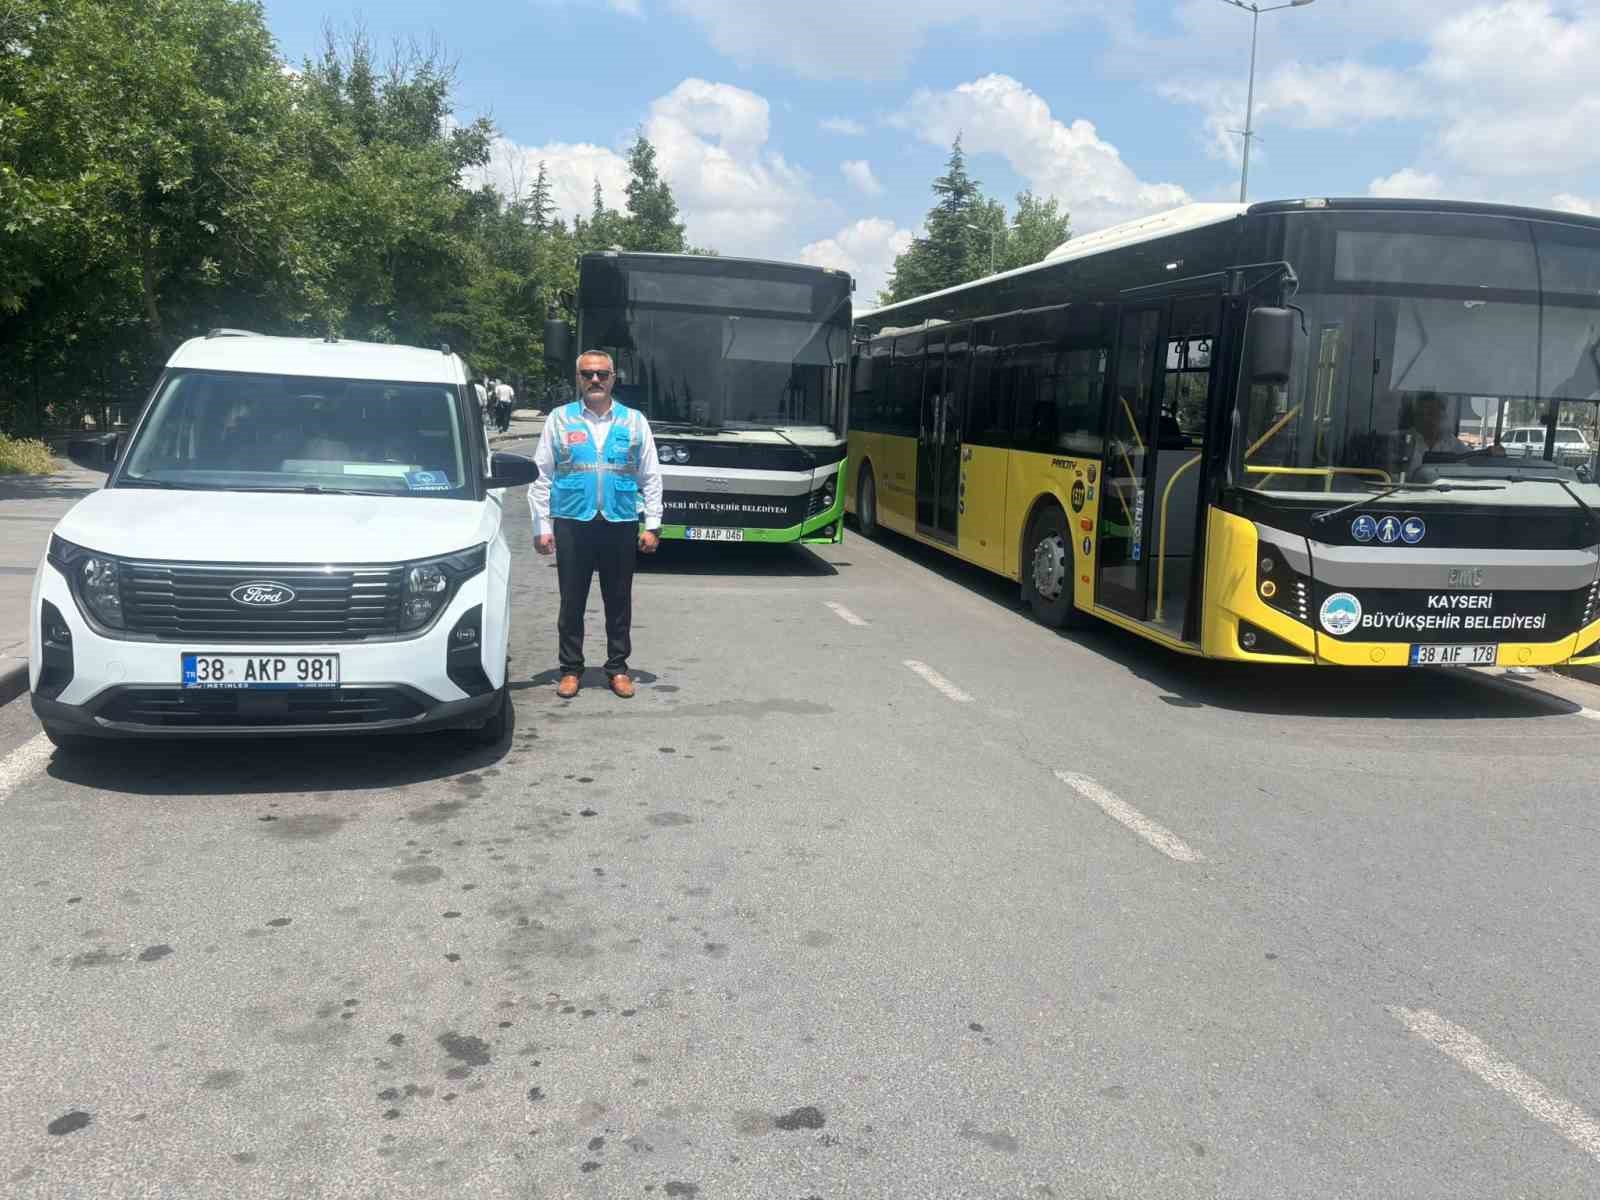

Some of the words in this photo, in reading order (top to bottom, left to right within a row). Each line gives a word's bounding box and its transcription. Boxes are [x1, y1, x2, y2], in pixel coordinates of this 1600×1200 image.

[691, 528, 702, 539] 38
[705, 529, 721, 540] AAP
[726, 529, 742, 540] 046
[243, 587, 283, 602] Ford
[1428, 592, 1493, 609] KAYSERİ
[1362, 612, 1460, 631] BÜYÜKŞEHİR
[1464, 612, 1546, 630] BELEDİYESİ
[1420, 647, 1436, 662] 38
[1440, 647, 1463, 662] AIF
[1472, 646, 1494, 662] 178
[198, 658, 225, 681] 38
[244, 658, 286, 681] AKP
[296, 658, 333, 681] 981
